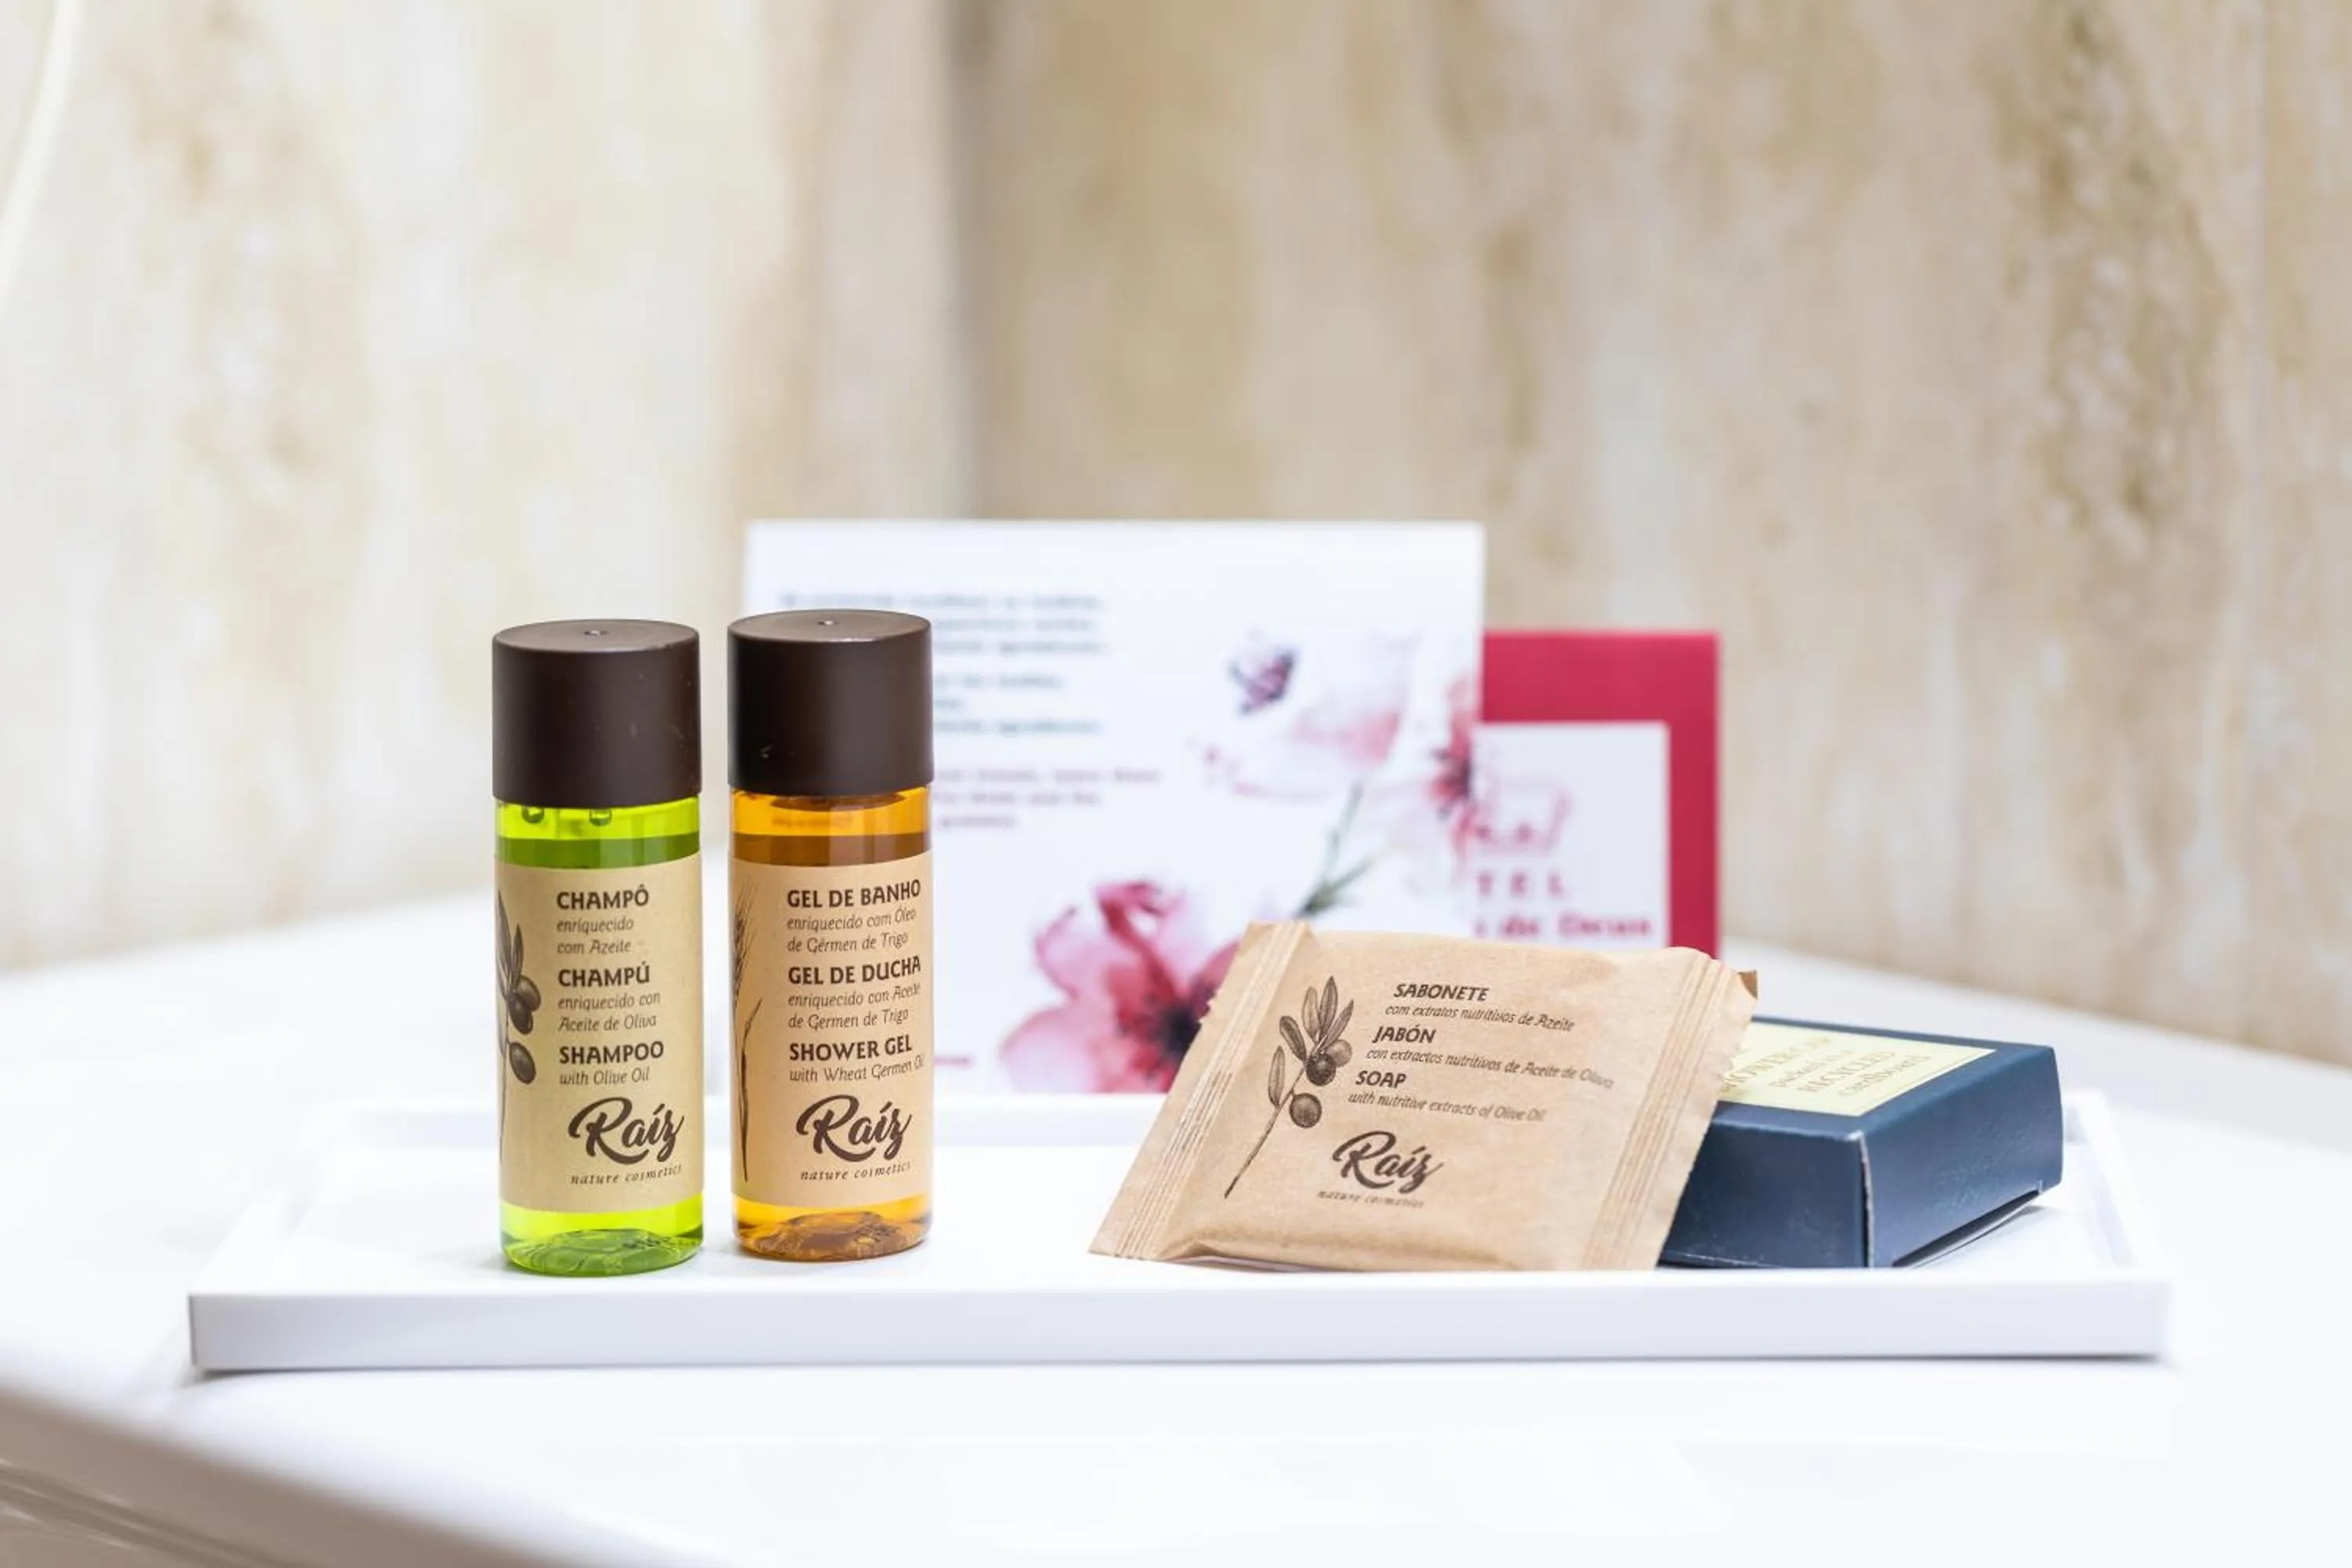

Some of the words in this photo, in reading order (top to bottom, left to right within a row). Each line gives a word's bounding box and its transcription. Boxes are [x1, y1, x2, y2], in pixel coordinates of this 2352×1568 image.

[557, 884, 649, 910] CHAMPÔ
[787, 889, 822, 908] GEL
[829, 889, 854, 907] DE
[862, 878, 921, 906] BANHO
[557, 918, 634, 935] enriquecido
[787, 916, 862, 933] enriquecido
[866, 913, 892, 927] com
[895, 907, 916, 925] Óleo
[557, 943, 585, 954] com
[589, 940, 631, 954] Azeite
[787, 938, 803, 953] de
[862, 934, 877, 949] de
[880, 932, 908, 949] Trigo
[558, 961, 650, 987] CHAMPÚ
[789, 967, 823, 985] GEL
[830, 966, 855, 984] DE
[862, 955, 921, 982] DUCHA
[558, 996, 635, 1011] enriquecido
[639, 991, 661, 1006] con
[788, 992, 863, 1010] enriquecido
[868, 990, 889, 1005] con
[1394, 983, 1489, 1001] SABONETE
[558, 1016, 599, 1032] Aceite
[603, 1016, 621, 1030] de
[624, 1014, 657, 1029] Oliva
[789, 1014, 804, 1029] de
[808, 1013, 858, 1031] Germen
[862, 1011, 877, 1026] de
[881, 1007, 909, 1025] Trigo
[1385, 1005, 1409, 1016] com
[1413, 1006, 1458, 1018] extratos
[1461, 1008, 1515, 1024] nutritivos
[1518, 1014, 1532, 1025] de
[1534, 1014, 1575, 1032] Azeite
[1372, 1025, 1436, 1044] JABÓN
[559, 1040, 664, 1064] SHAMPOO
[789, 1040, 879, 1062] SHOWER
[884, 1035, 913, 1056] GEL
[559, 1071, 589, 1086] with
[593, 1068, 627, 1085] Olive
[631, 1066, 650, 1083] Oil
[789, 1067, 818, 1083] with
[823, 1065, 867, 1082] Wheat
[872, 1061, 913, 1080] Germen
[1367, 1048, 1388, 1059] con
[1391, 1049, 1443, 1064] extractos
[1446, 1054, 1501, 1072] nutritivos
[1504, 1061, 1520, 1073] de
[1522, 1062, 1560, 1078] Aceite
[1561, 1067, 1577, 1080] de
[1356, 1069, 1407, 1090] SOAP
[1348, 1087, 1374, 1104] with
[1377, 1091, 1427, 1110] nutritive
[1429, 1100, 1476, 1116] extracts
[1479, 1105, 1494, 1118] of
[568, 1097, 685, 1165] Raíz
[796, 1094, 913, 1162] Raíz
[800, 1169, 848, 1181] nature
[855, 1162, 911, 1178] cosmetics
[1332, 1131, 1444, 1193] Raíz
[571, 1173, 619, 1185] nature
[625, 1164, 682, 1182] cosmetics
